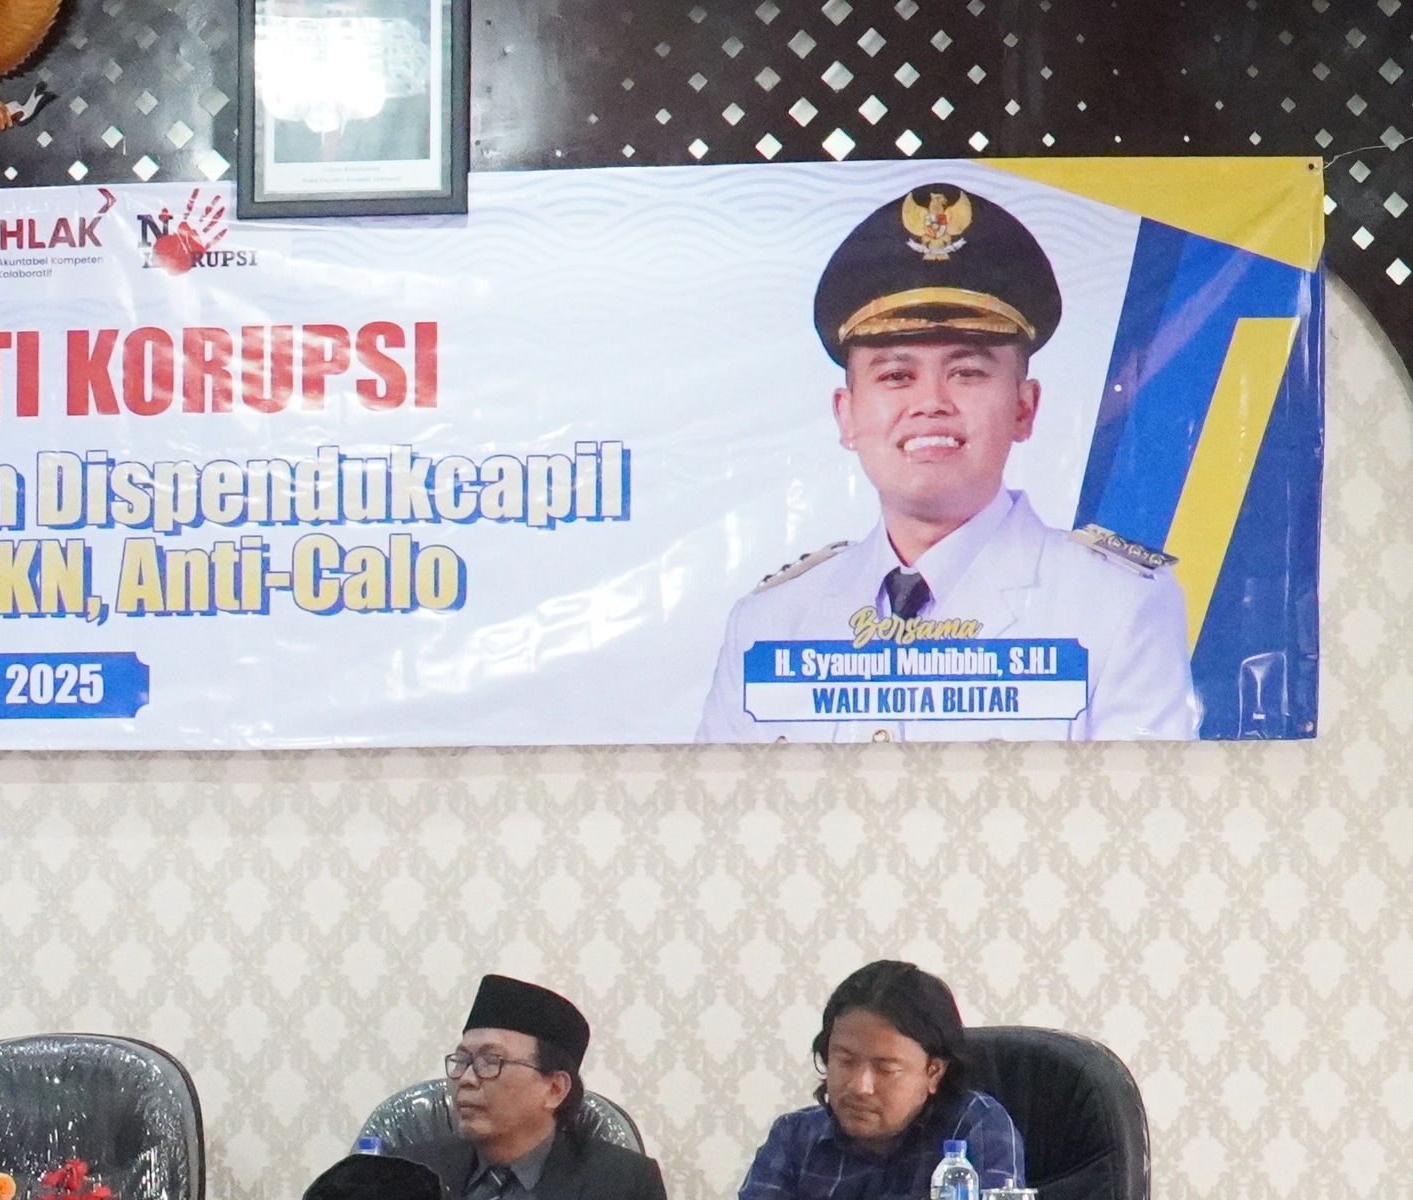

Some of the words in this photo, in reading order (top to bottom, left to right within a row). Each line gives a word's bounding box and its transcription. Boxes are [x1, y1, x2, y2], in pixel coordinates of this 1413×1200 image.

[51, 255, 104, 267] Kompeten
[142, 249, 258, 268] KRUPSI
[65, 321, 439, 417] KORUPSI
[36, 441, 631, 536] Dispendukcapil
[116, 533, 467, 618] Anti-Calo
[849, 605, 983, 649] Bersama
[5, 664, 105, 704] 2025
[775, 649, 796, 676] H.
[801, 648, 891, 681] Syauqul
[896, 647, 1003, 678] Muhibbin,
[812, 687, 870, 714] WALI
[877, 686, 934, 714] KOTA
[942, 686, 1019, 713] BLITAR
